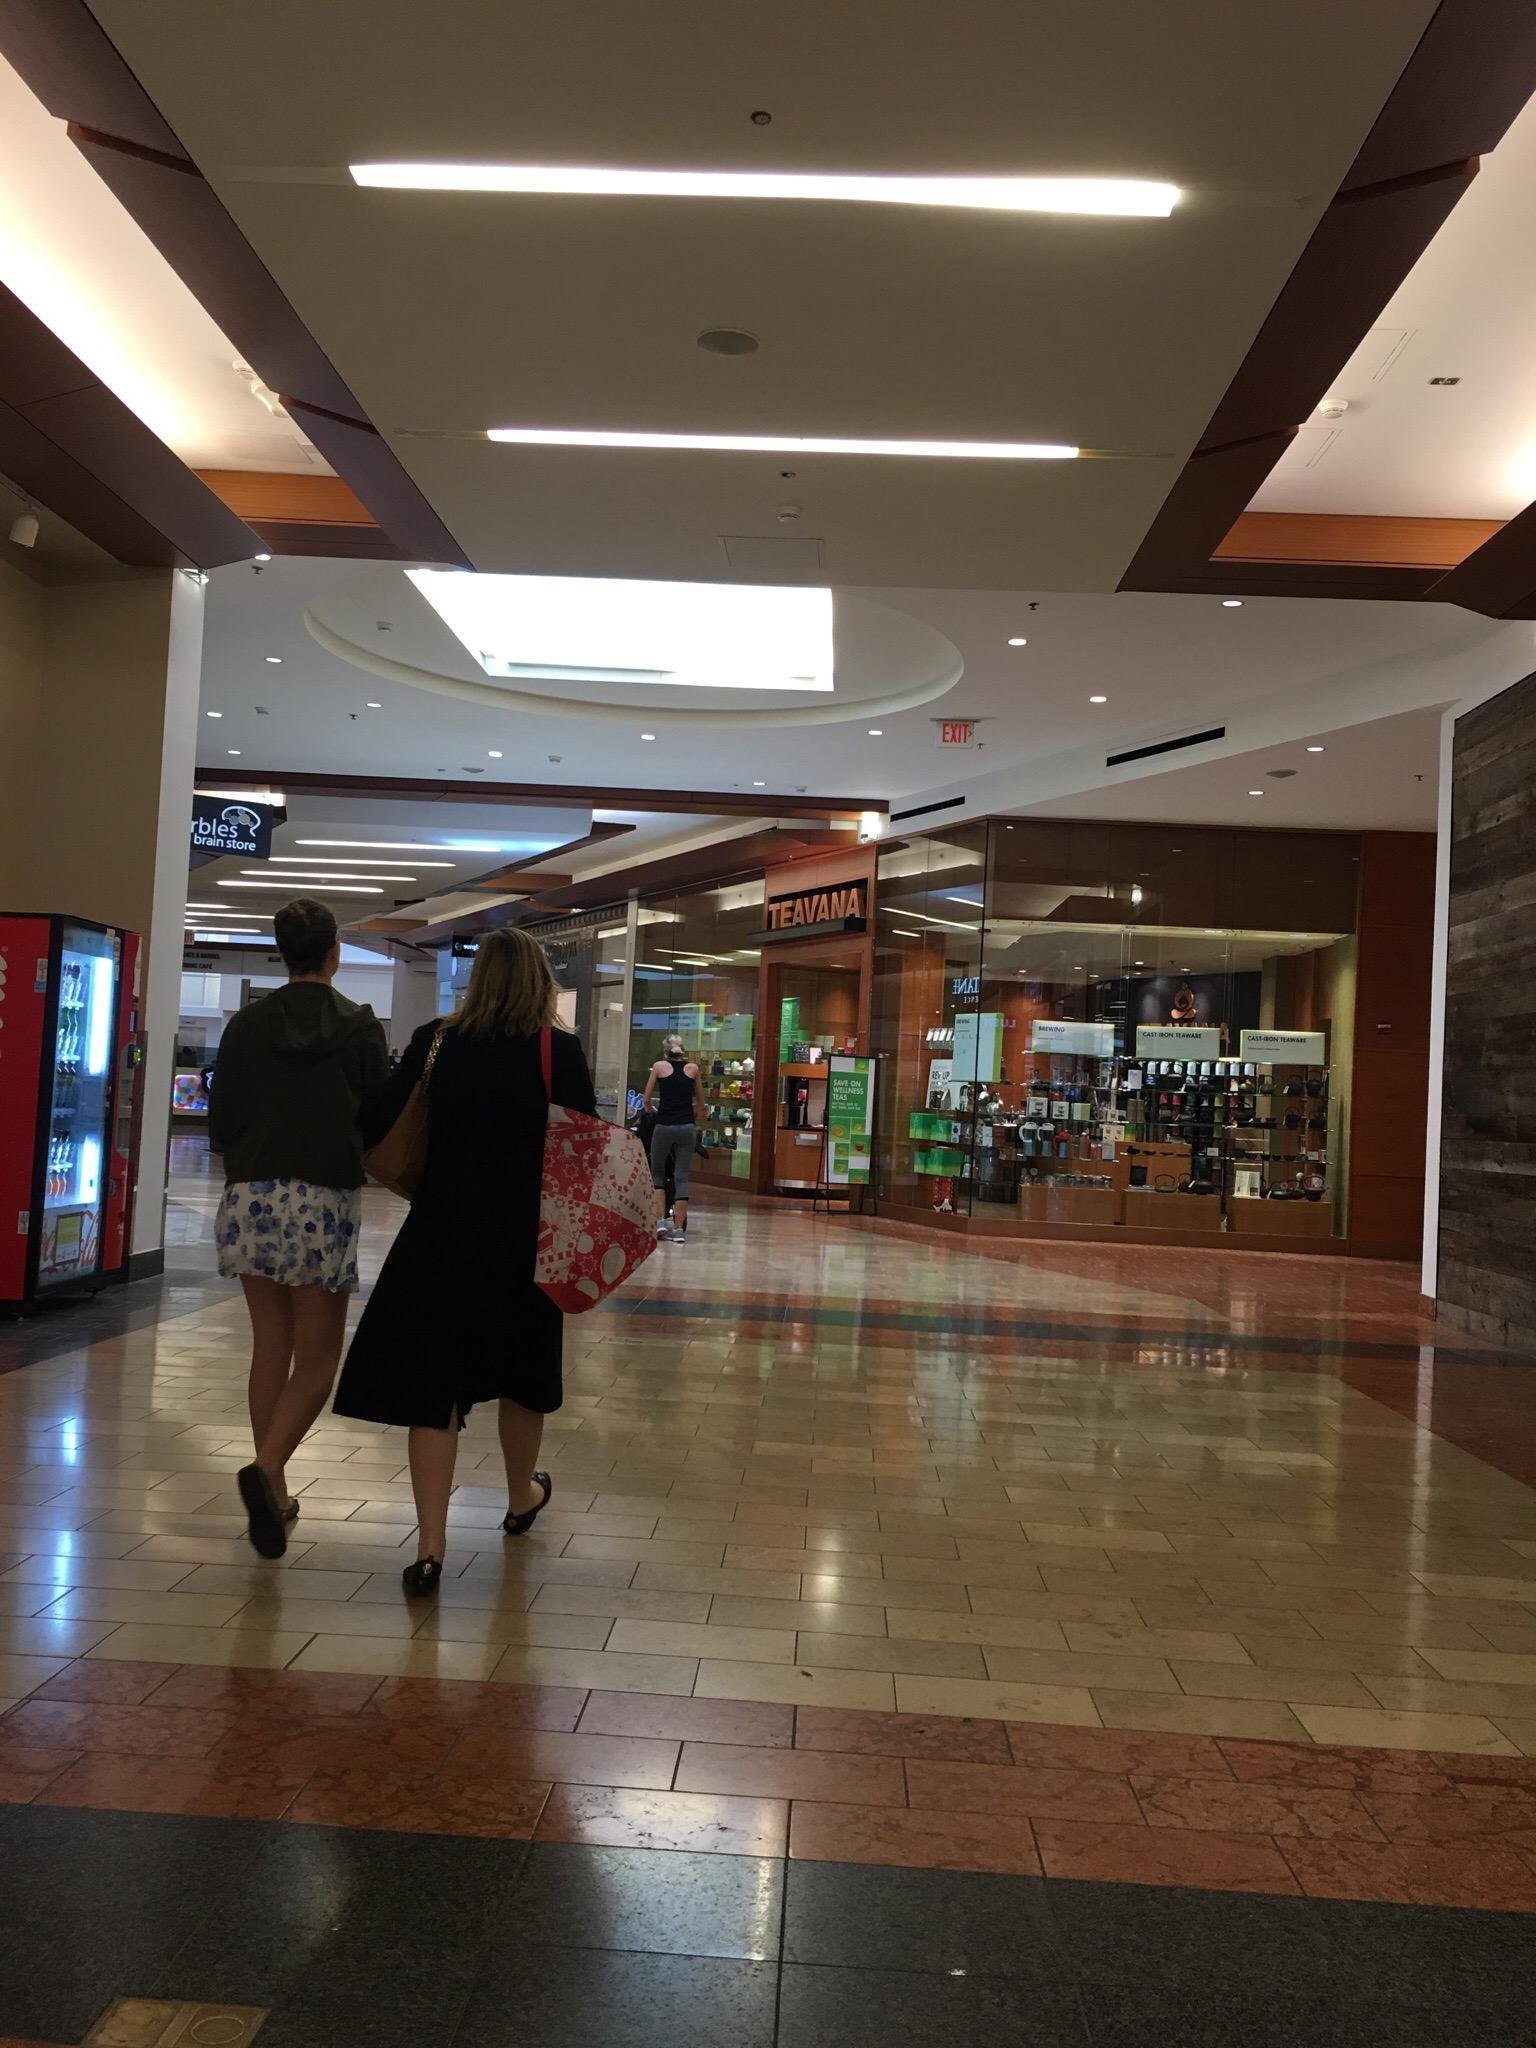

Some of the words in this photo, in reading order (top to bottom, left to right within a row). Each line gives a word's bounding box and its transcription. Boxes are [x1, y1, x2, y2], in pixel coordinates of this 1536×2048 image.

[942, 722, 969, 744] EXIT
[193, 833, 224, 848] brain
[225, 839, 257, 852] store
[768, 887, 861, 930] TEAVANA
[832, 1087, 864, 1095] WELLNESS
[833, 1079, 849, 1087] SAVE
[850, 1080, 862, 1088] ON
